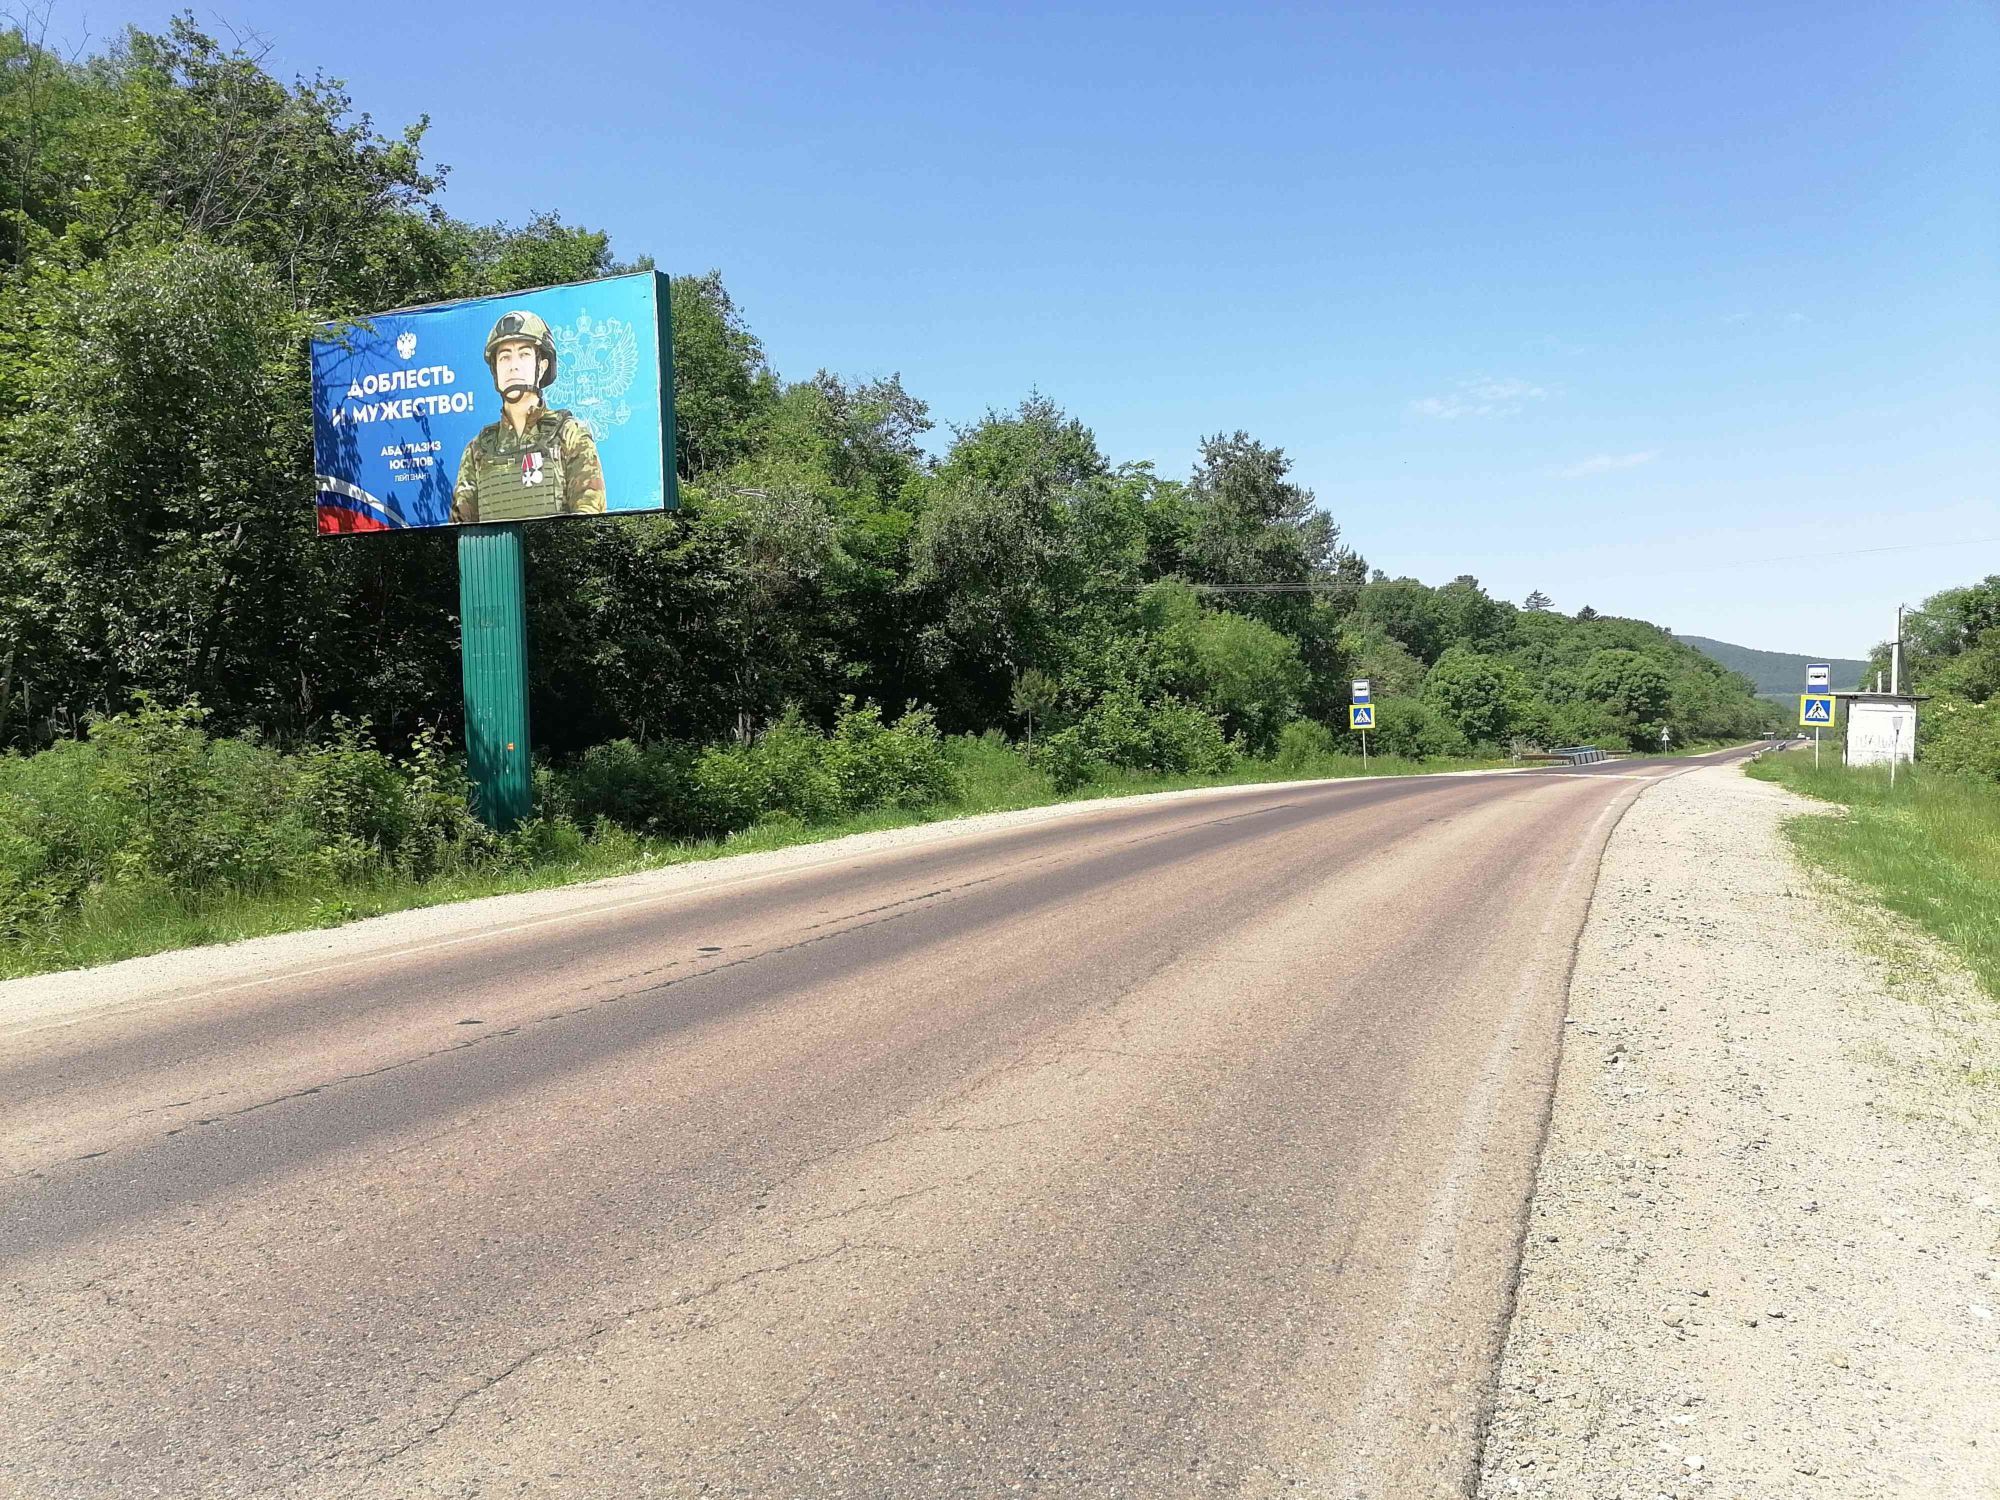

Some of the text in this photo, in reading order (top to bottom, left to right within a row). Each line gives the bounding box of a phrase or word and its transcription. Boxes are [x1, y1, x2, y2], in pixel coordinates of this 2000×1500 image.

[347, 365, 455, 399] ДОБЛЕСТЬ
[332, 391, 474, 427] И МУЖЕСТВО!
[381, 441, 441, 456] АБДУЛАЗИЗ
[389, 456, 434, 470] ЮСУПОВ
